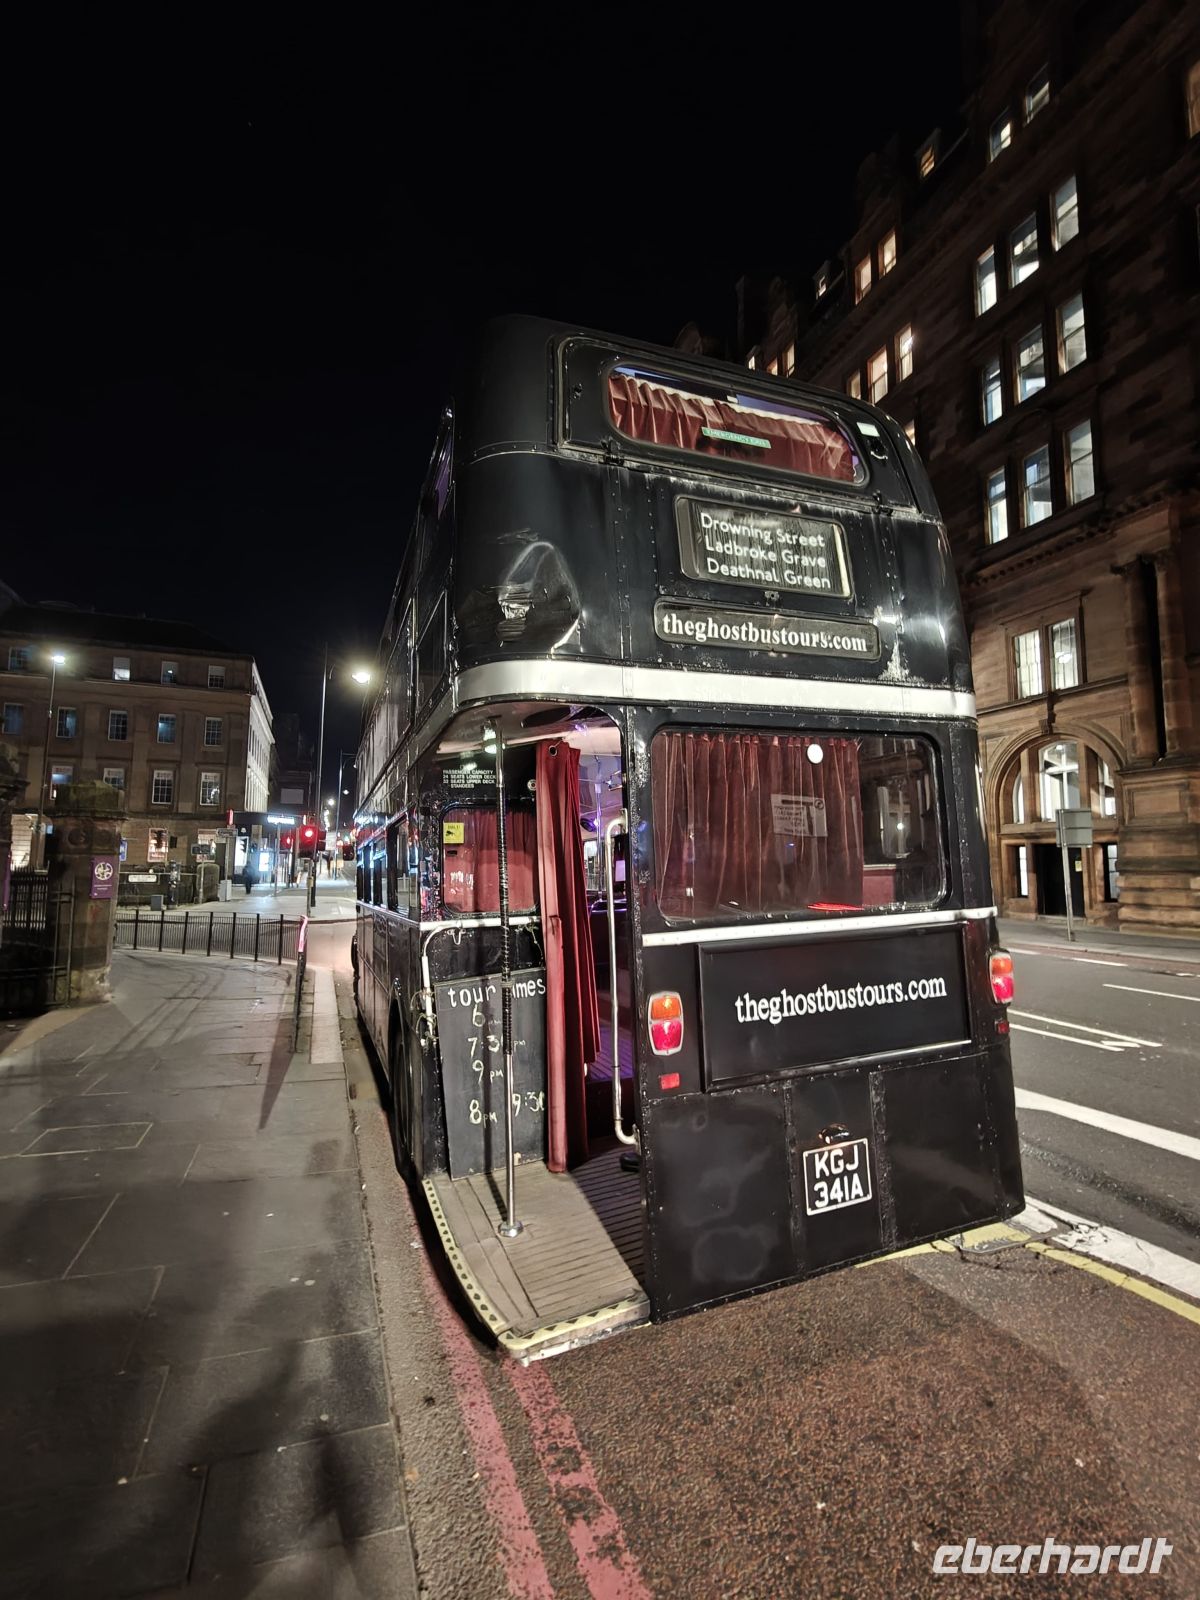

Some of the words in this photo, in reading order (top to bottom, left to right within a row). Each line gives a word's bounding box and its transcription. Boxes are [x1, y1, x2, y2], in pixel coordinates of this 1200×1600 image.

[700, 511, 772, 546] Drowning
[776, 527, 826, 548] Street
[705, 534, 777, 562] Ladbroke
[781, 548, 826, 569] Grave
[706, 556, 780, 583] Deathnal
[783, 569, 831, 589] Green
[662, 612, 868, 652] theghostbustours.com
[448, 984, 497, 1008] tour
[734, 976, 948, 1026] theghostbustours.com
[472, 1003, 486, 1027] 6
[472, 1060, 485, 1085] 9
[469, 1099, 482, 1124] 8
[814, 1144, 859, 1179] KGJ
[813, 1172, 864, 1208] 341A
